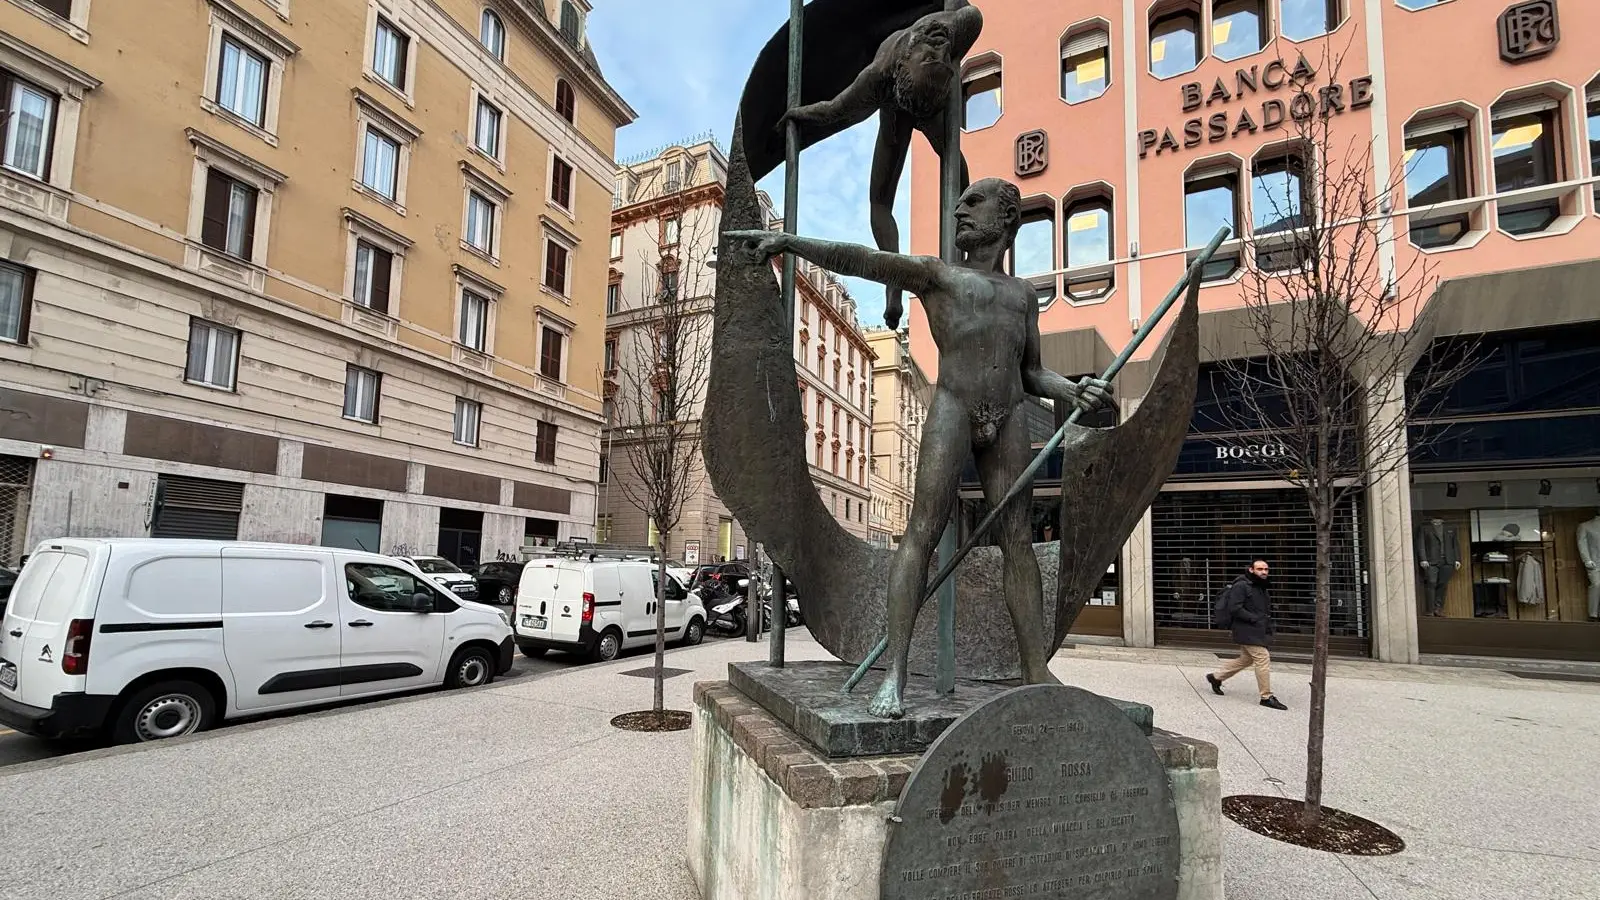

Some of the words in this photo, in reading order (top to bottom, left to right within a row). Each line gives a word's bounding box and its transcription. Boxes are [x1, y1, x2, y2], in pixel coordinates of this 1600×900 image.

[1181, 54, 1315, 112] BANCA
[1138, 75, 1374, 159] PASSADORE
[1216, 444, 1285, 459] BOGGI
[146, 481, 156, 522] TICKET
[1006, 765, 1034, 783] GUIDO
[1060, 761, 1092, 777] ROSSA
[995, 828, 1018, 842] PAURA
[1026, 825, 1047, 838] DELLA
[902, 868, 925, 883] VOLLE
[929, 863, 961, 880] COMPIERE
[992, 856, 1016, 871] DOVERE
[1004, 884, 1024, 898] ROSSE
[1078, 873, 1091, 887] PER
[1094, 869, 1122, 883] COLPIRLO
